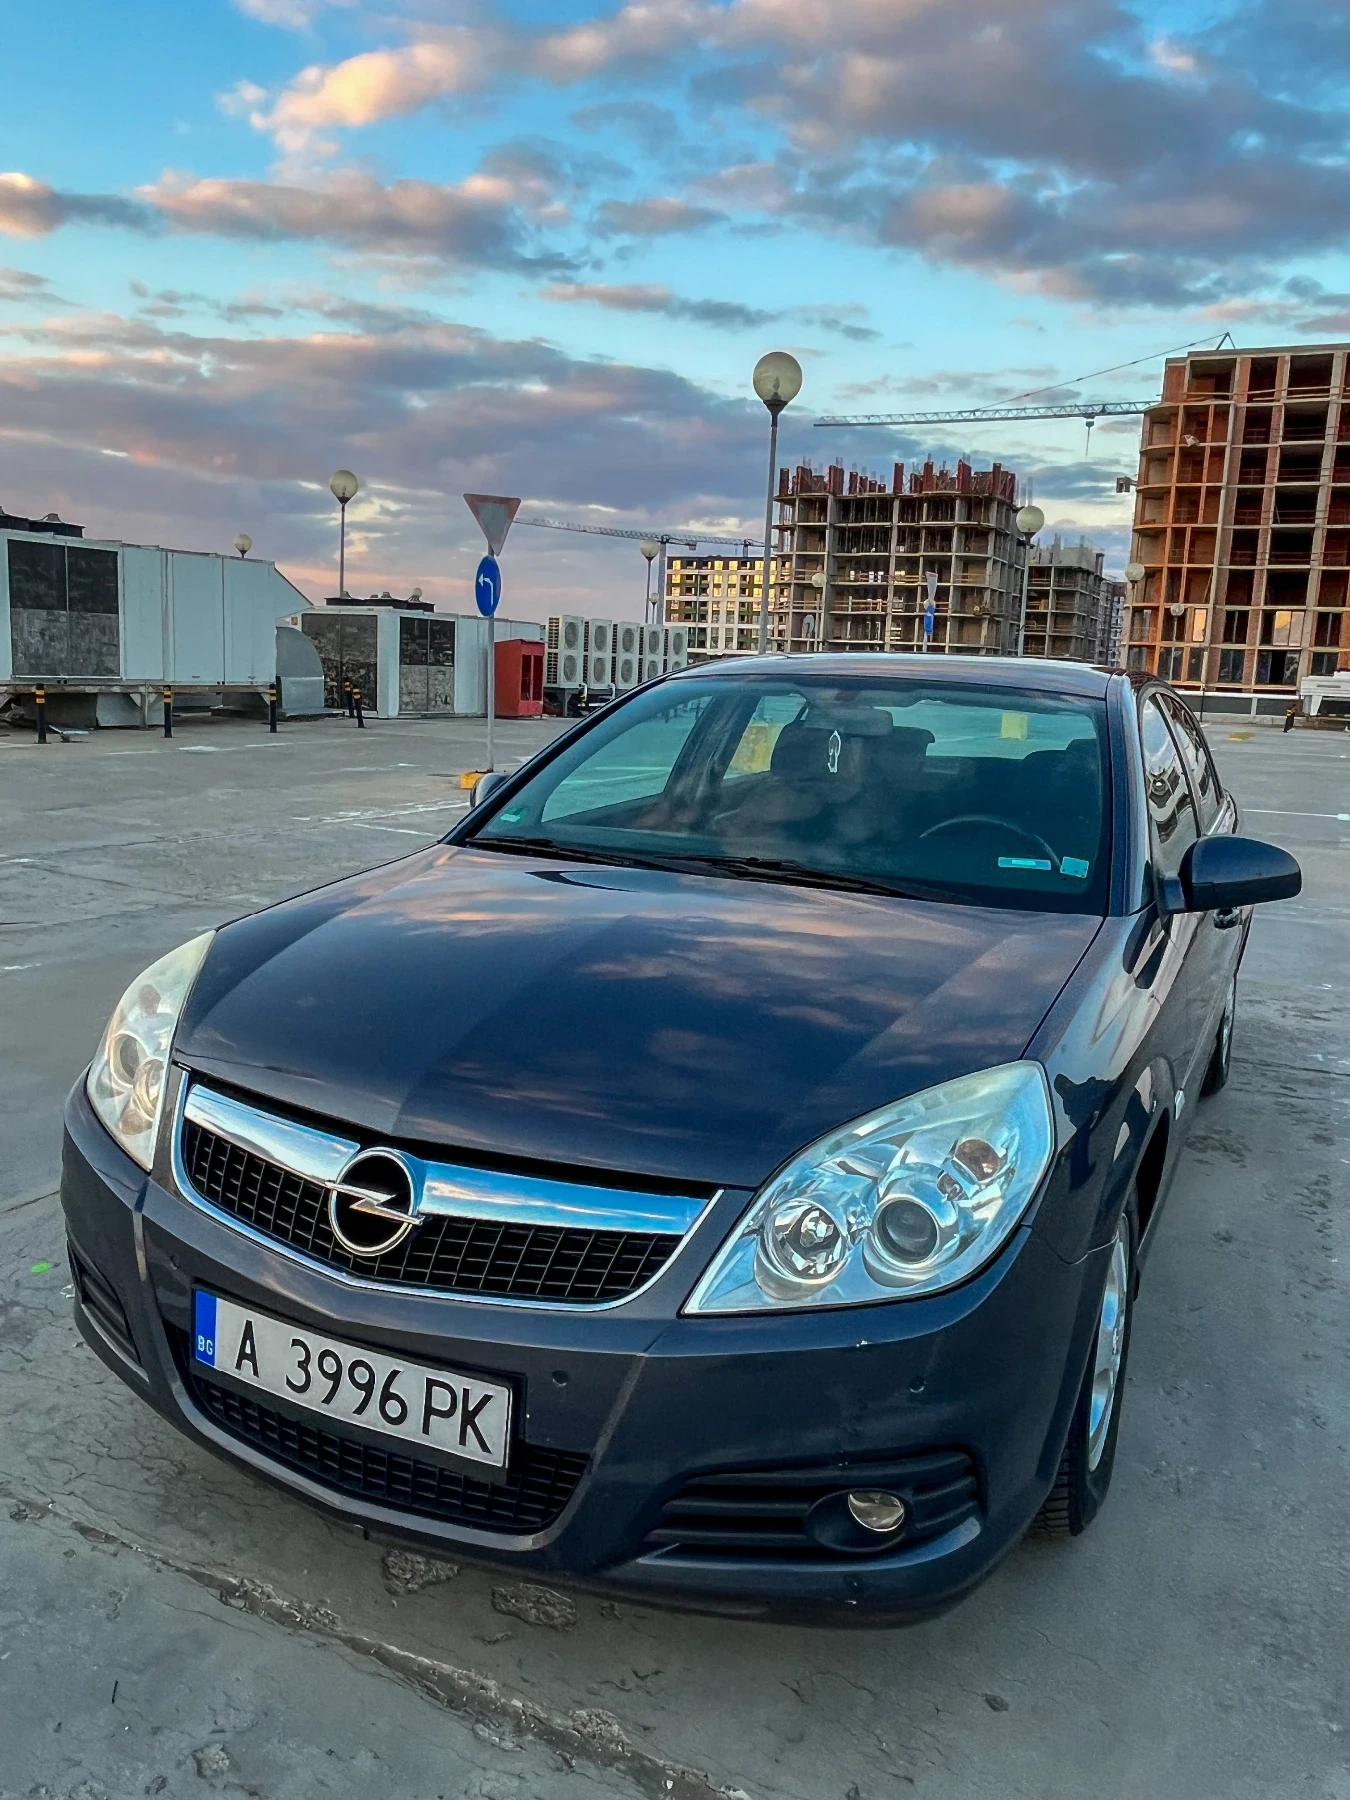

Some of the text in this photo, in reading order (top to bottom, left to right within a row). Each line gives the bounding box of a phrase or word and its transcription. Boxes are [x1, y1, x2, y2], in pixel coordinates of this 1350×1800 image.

[197, 1335, 214, 1356] BG
[235, 1320, 494, 1455] A 3996 PK
